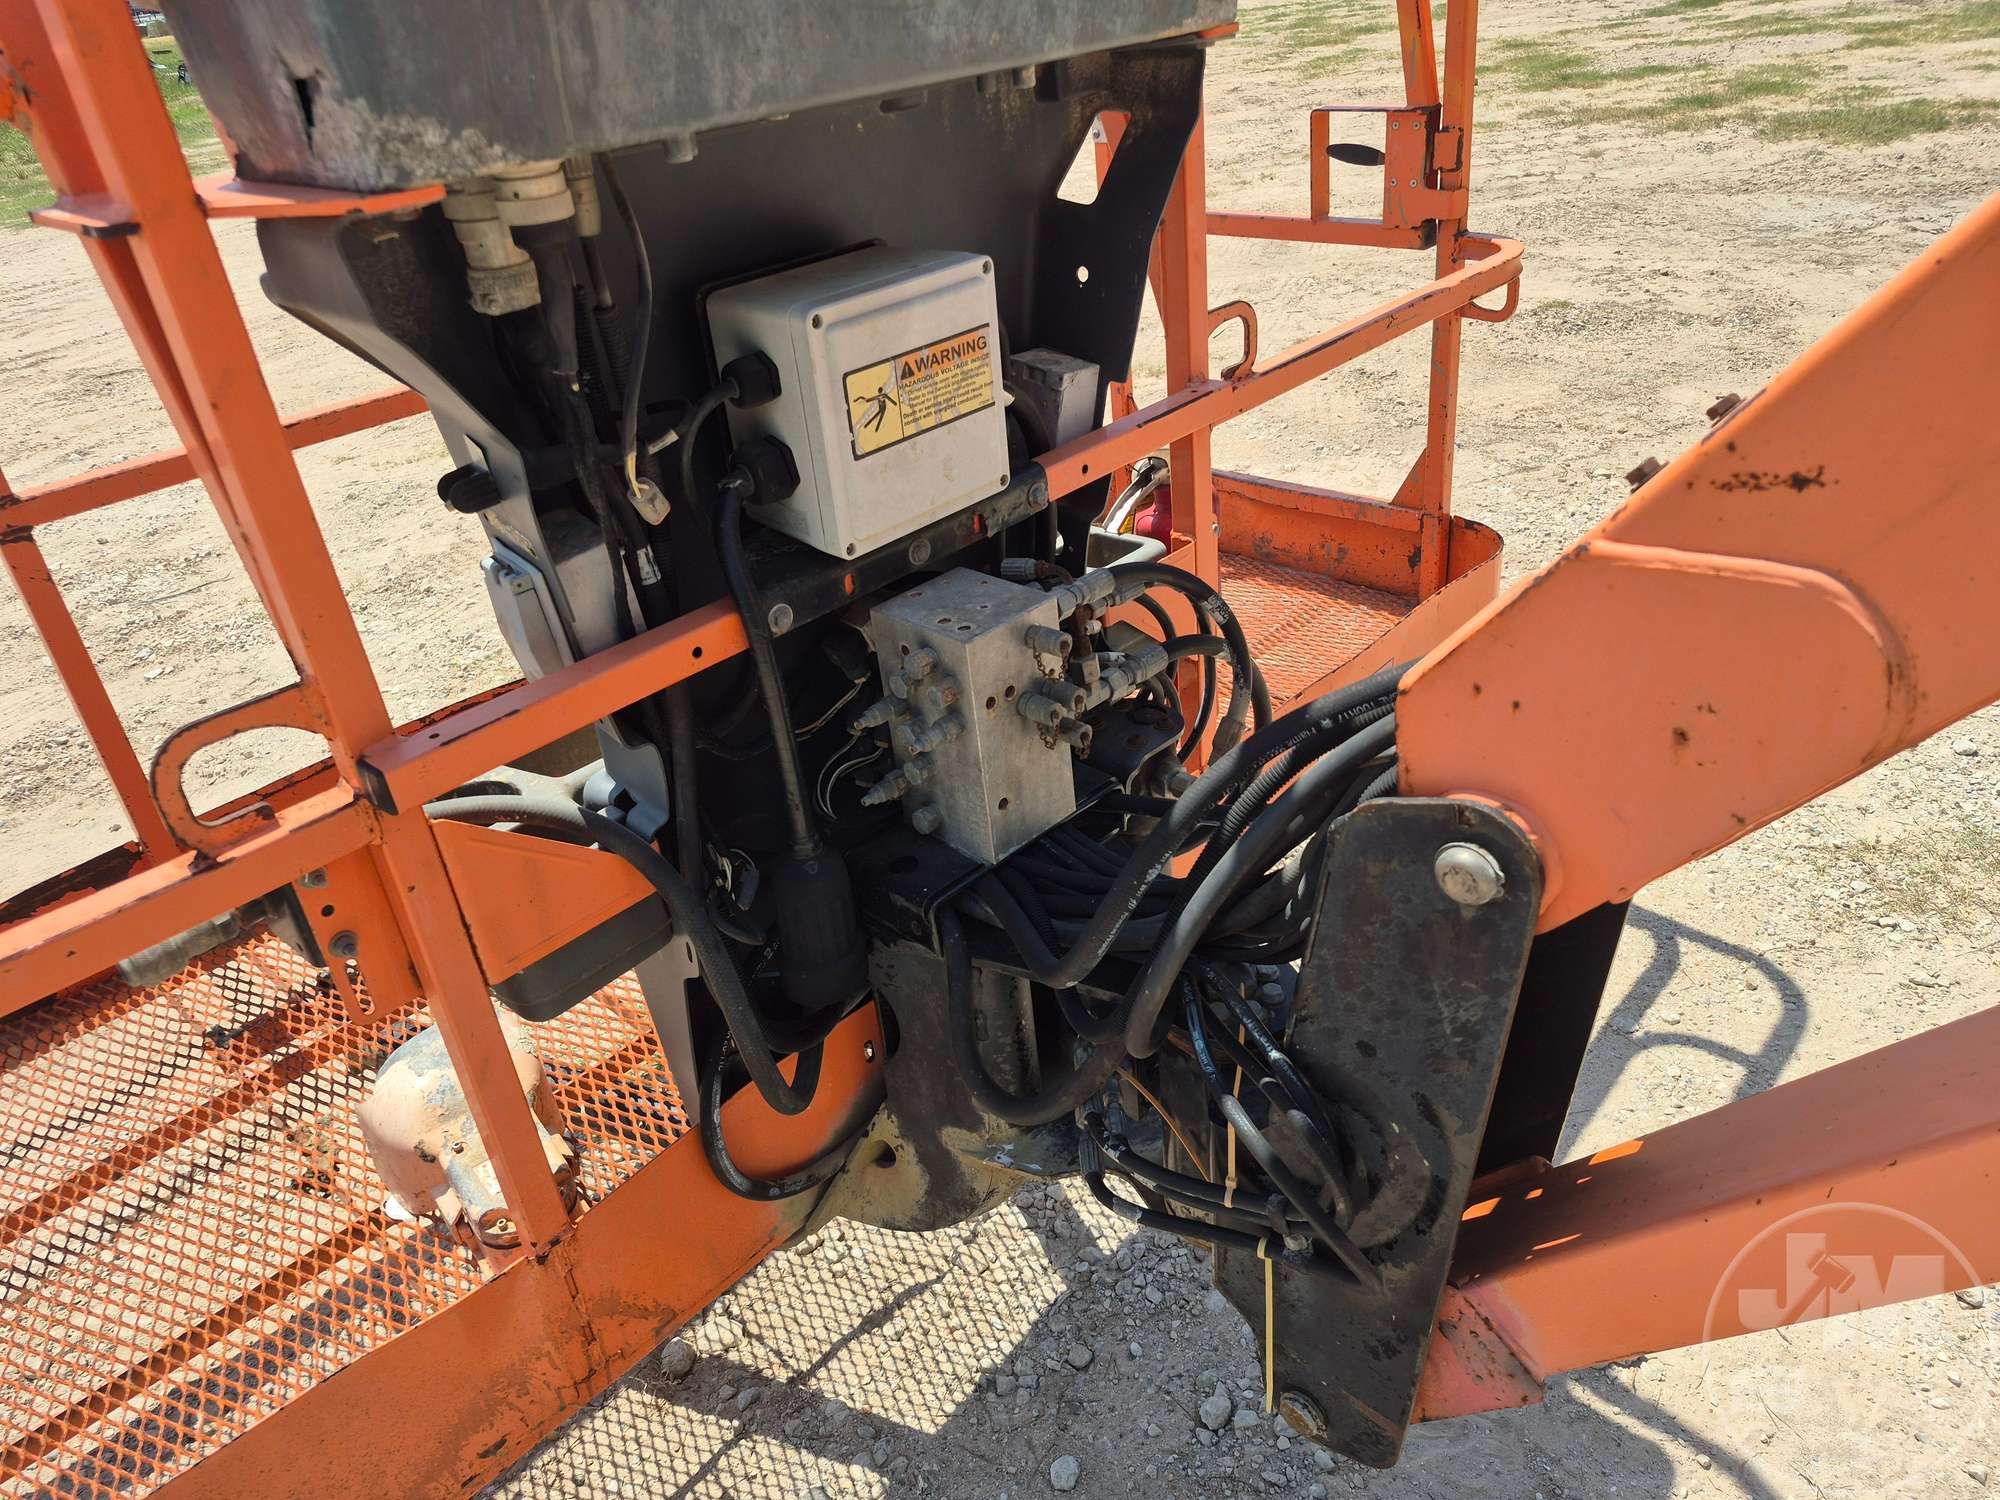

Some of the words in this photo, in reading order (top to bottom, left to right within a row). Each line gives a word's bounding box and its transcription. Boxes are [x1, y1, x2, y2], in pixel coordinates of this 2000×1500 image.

[914, 336, 986, 372] WARNING
[898, 371, 939, 390] HAZARDOUS
[940, 361, 969, 375] VOLTAGE
